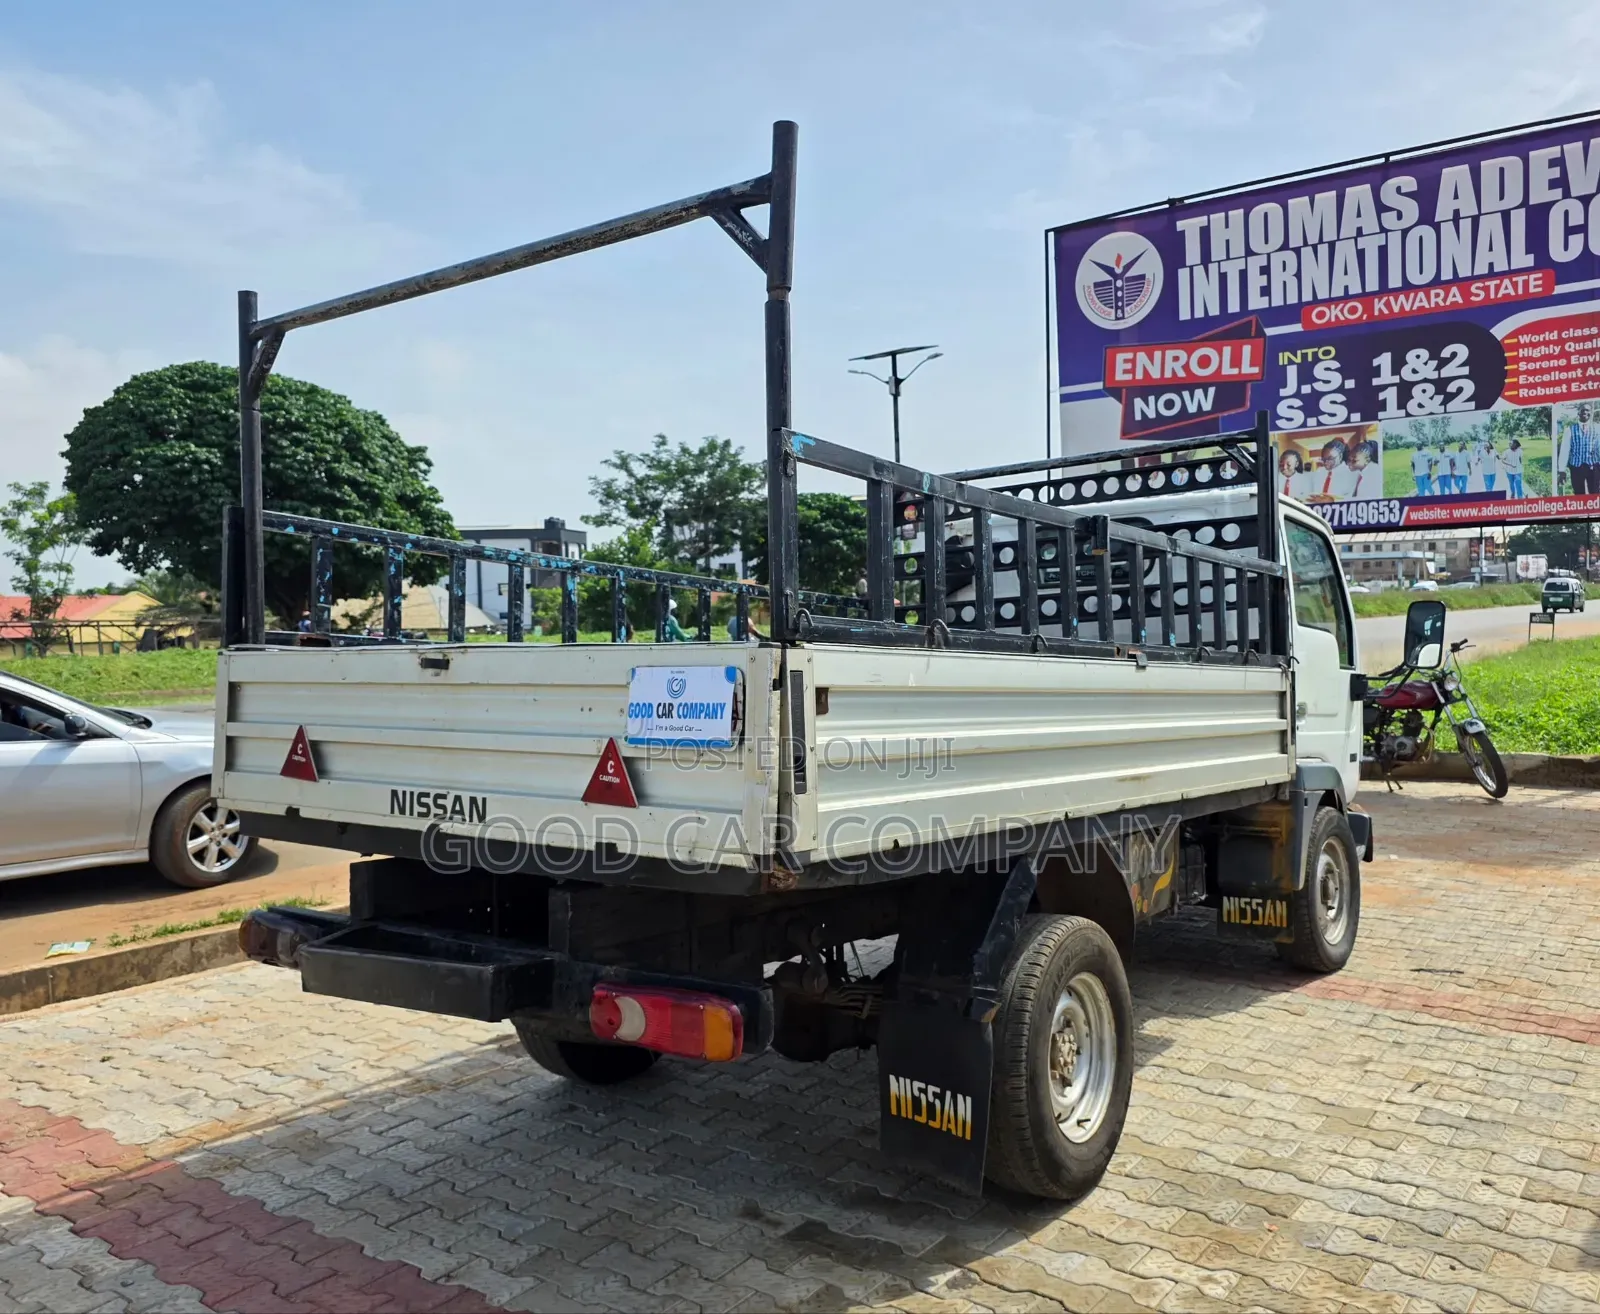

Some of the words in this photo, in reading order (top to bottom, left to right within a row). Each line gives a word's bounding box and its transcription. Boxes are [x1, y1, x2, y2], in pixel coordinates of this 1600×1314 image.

[1176, 175, 1420, 267] THOMAS
[1177, 207, 1534, 321] INTERNATIONAL
[1311, 301, 1368, 325] OKO,
[1374, 285, 1463, 315] KWARA
[1470, 272, 1543, 302] STATE
[1518, 330, 1558, 344] World
[1561, 326, 1599, 339] class
[1278, 345, 1336, 366] INTO
[1518, 344, 1561, 358] Highly
[1114, 344, 1259, 381] ENROLL
[1279, 360, 1356, 397] J.S.
[1372, 343, 1470, 386] 1&2
[1518, 358, 1567, 371] Serene
[1570, 352, 1600, 365] Envi
[1519, 368, 1583, 385] Excellent
[1519, 383, 1568, 398] Robust
[1133, 386, 1216, 421] NOW
[1275, 393, 1361, 429] S.S.
[1377, 378, 1476, 420] 1&2
[1410, 507, 1450, 521] website:
[628, 702, 654, 719] GOOD
[656, 702, 675, 719] CAR
[677, 702, 727, 720] COMPANY
[669, 724, 684, 732] Good
[684, 724, 695, 732] Car
[297, 743, 303, 754] C
[607, 760, 615, 774] C
[599, 774, 620, 784] CAUTION
[390, 788, 487, 824] NISSAN
[1222, 895, 1288, 928] NISSAN
[889, 1073, 972, 1141] NISSAN
